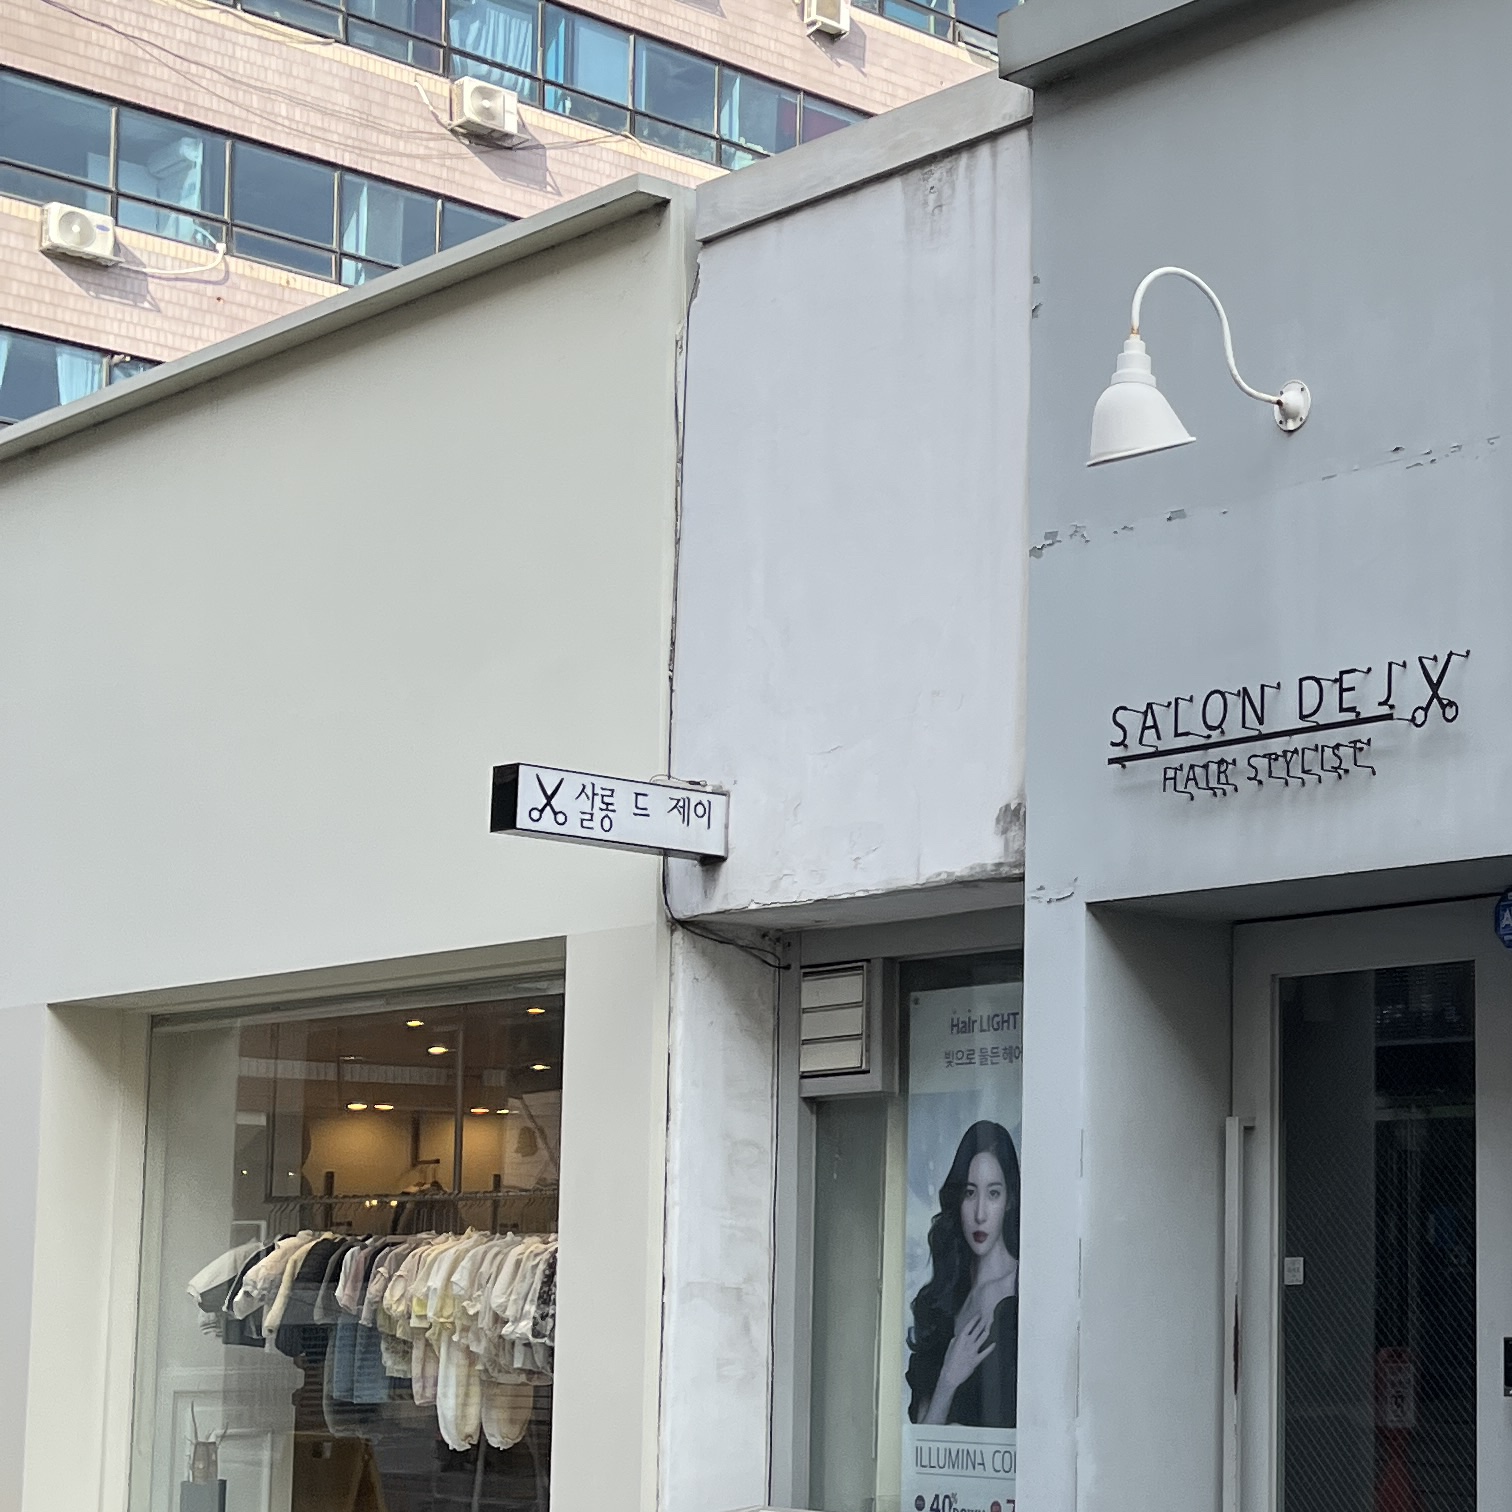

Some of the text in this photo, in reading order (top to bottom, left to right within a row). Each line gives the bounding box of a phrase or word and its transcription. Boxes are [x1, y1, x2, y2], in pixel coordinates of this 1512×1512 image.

[1109, 682, 1279, 750] SALON
[1163, 758, 1236, 801] HAIR
[575, 782, 711, 832] 살롱 드 제이
[950, 1009, 1019, 1034] Hair LIGHT
[915, 1446, 986, 1473] ILLUMINA
